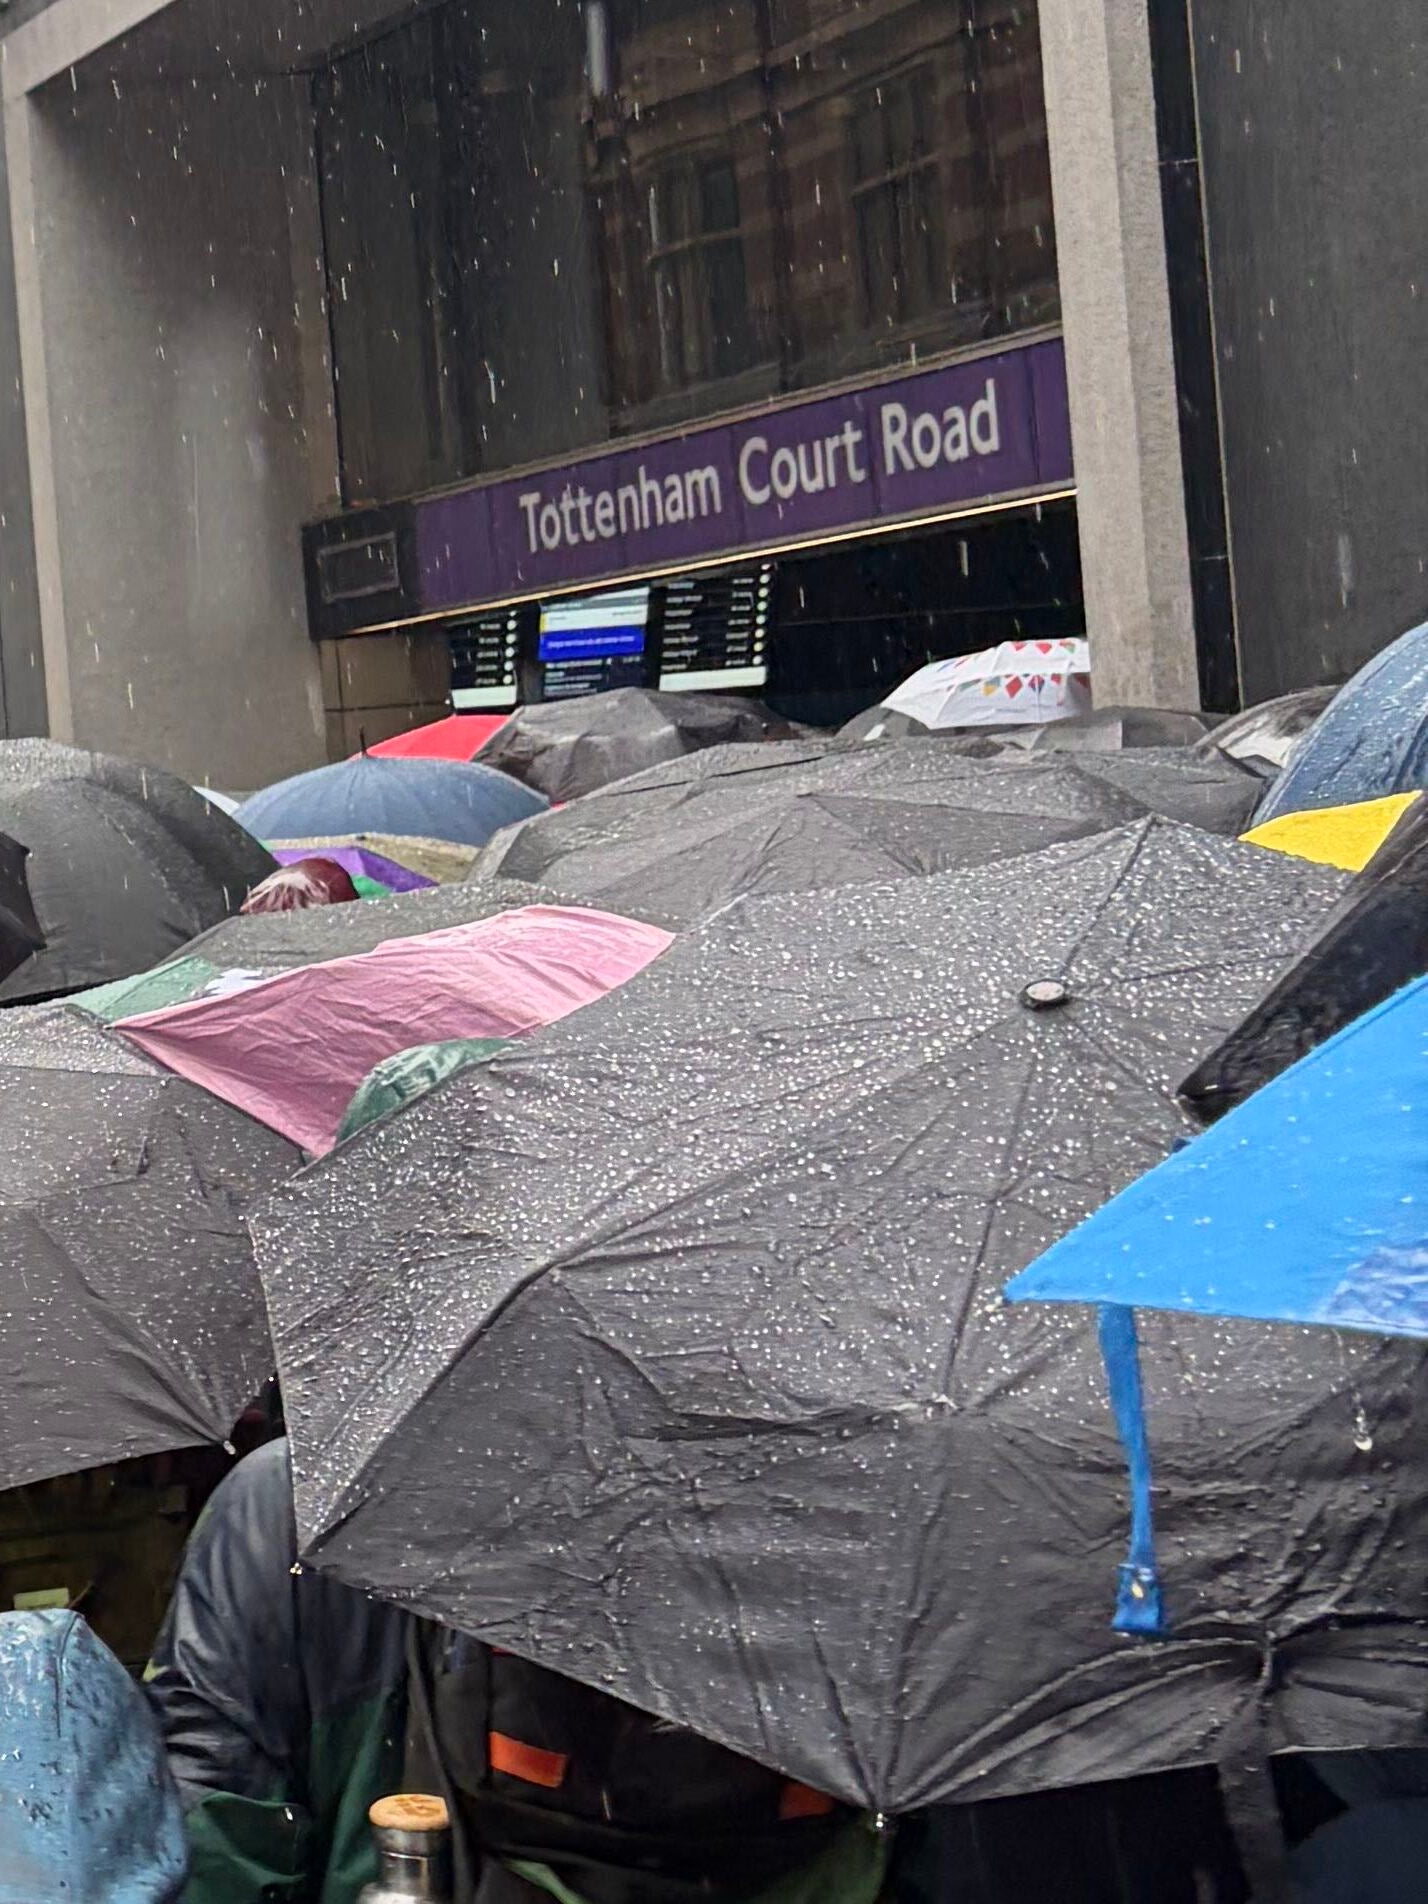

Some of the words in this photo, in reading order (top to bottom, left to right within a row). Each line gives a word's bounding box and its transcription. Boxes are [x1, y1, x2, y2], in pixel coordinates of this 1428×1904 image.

[519, 464, 723, 554] Tottenham
[739, 421, 866, 505] Court
[880, 378, 1001, 476] Road
